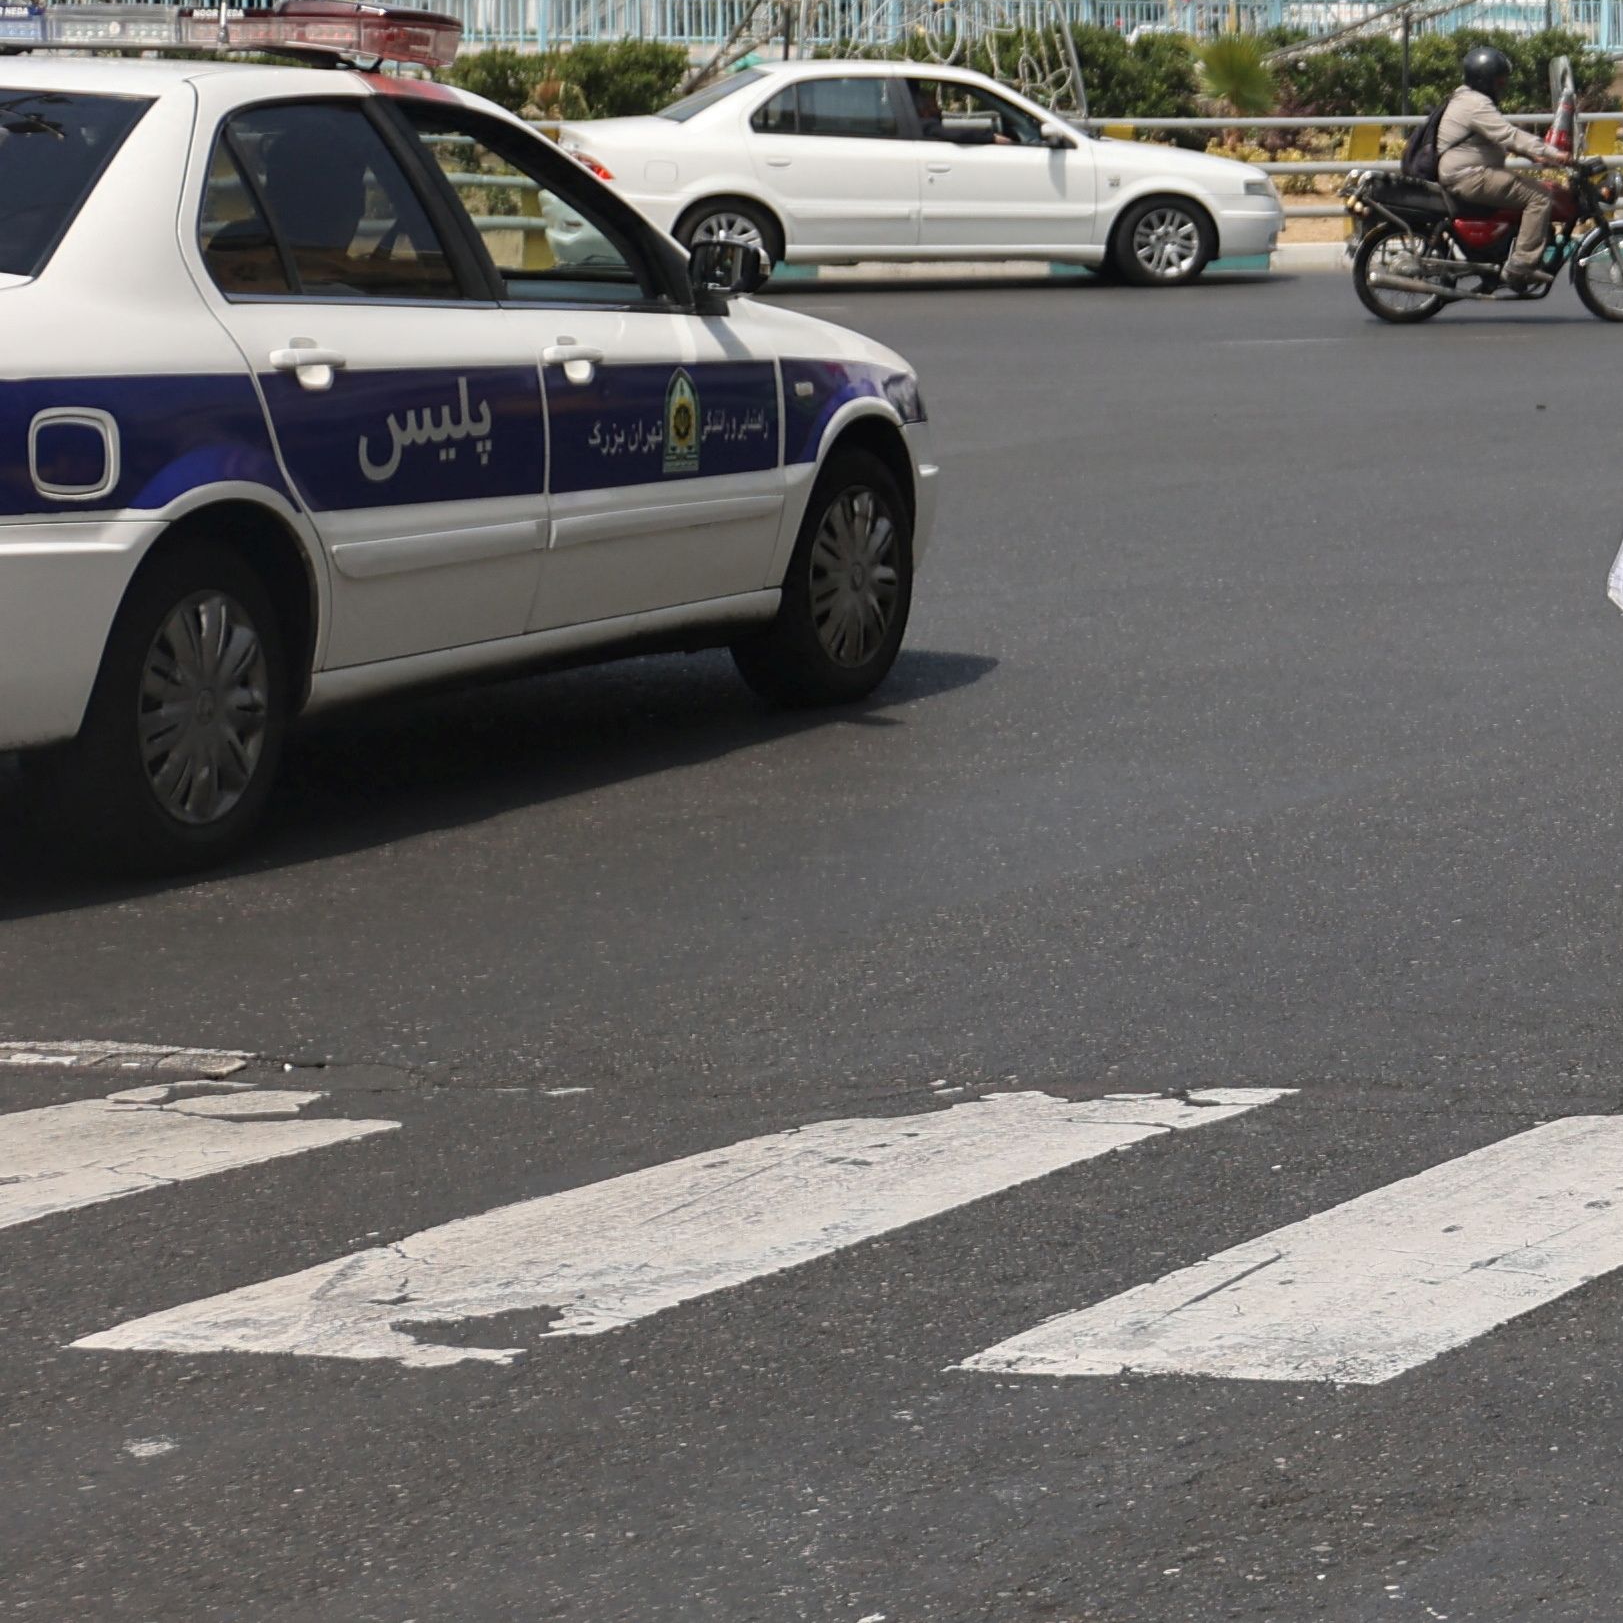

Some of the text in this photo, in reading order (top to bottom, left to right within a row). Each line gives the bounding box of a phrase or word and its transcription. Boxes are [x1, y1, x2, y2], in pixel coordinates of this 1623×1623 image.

[358, 376, 493, 482] پلیس
[587, 420, 626, 456] بزرگ
[627, 418, 663, 454] تهران
